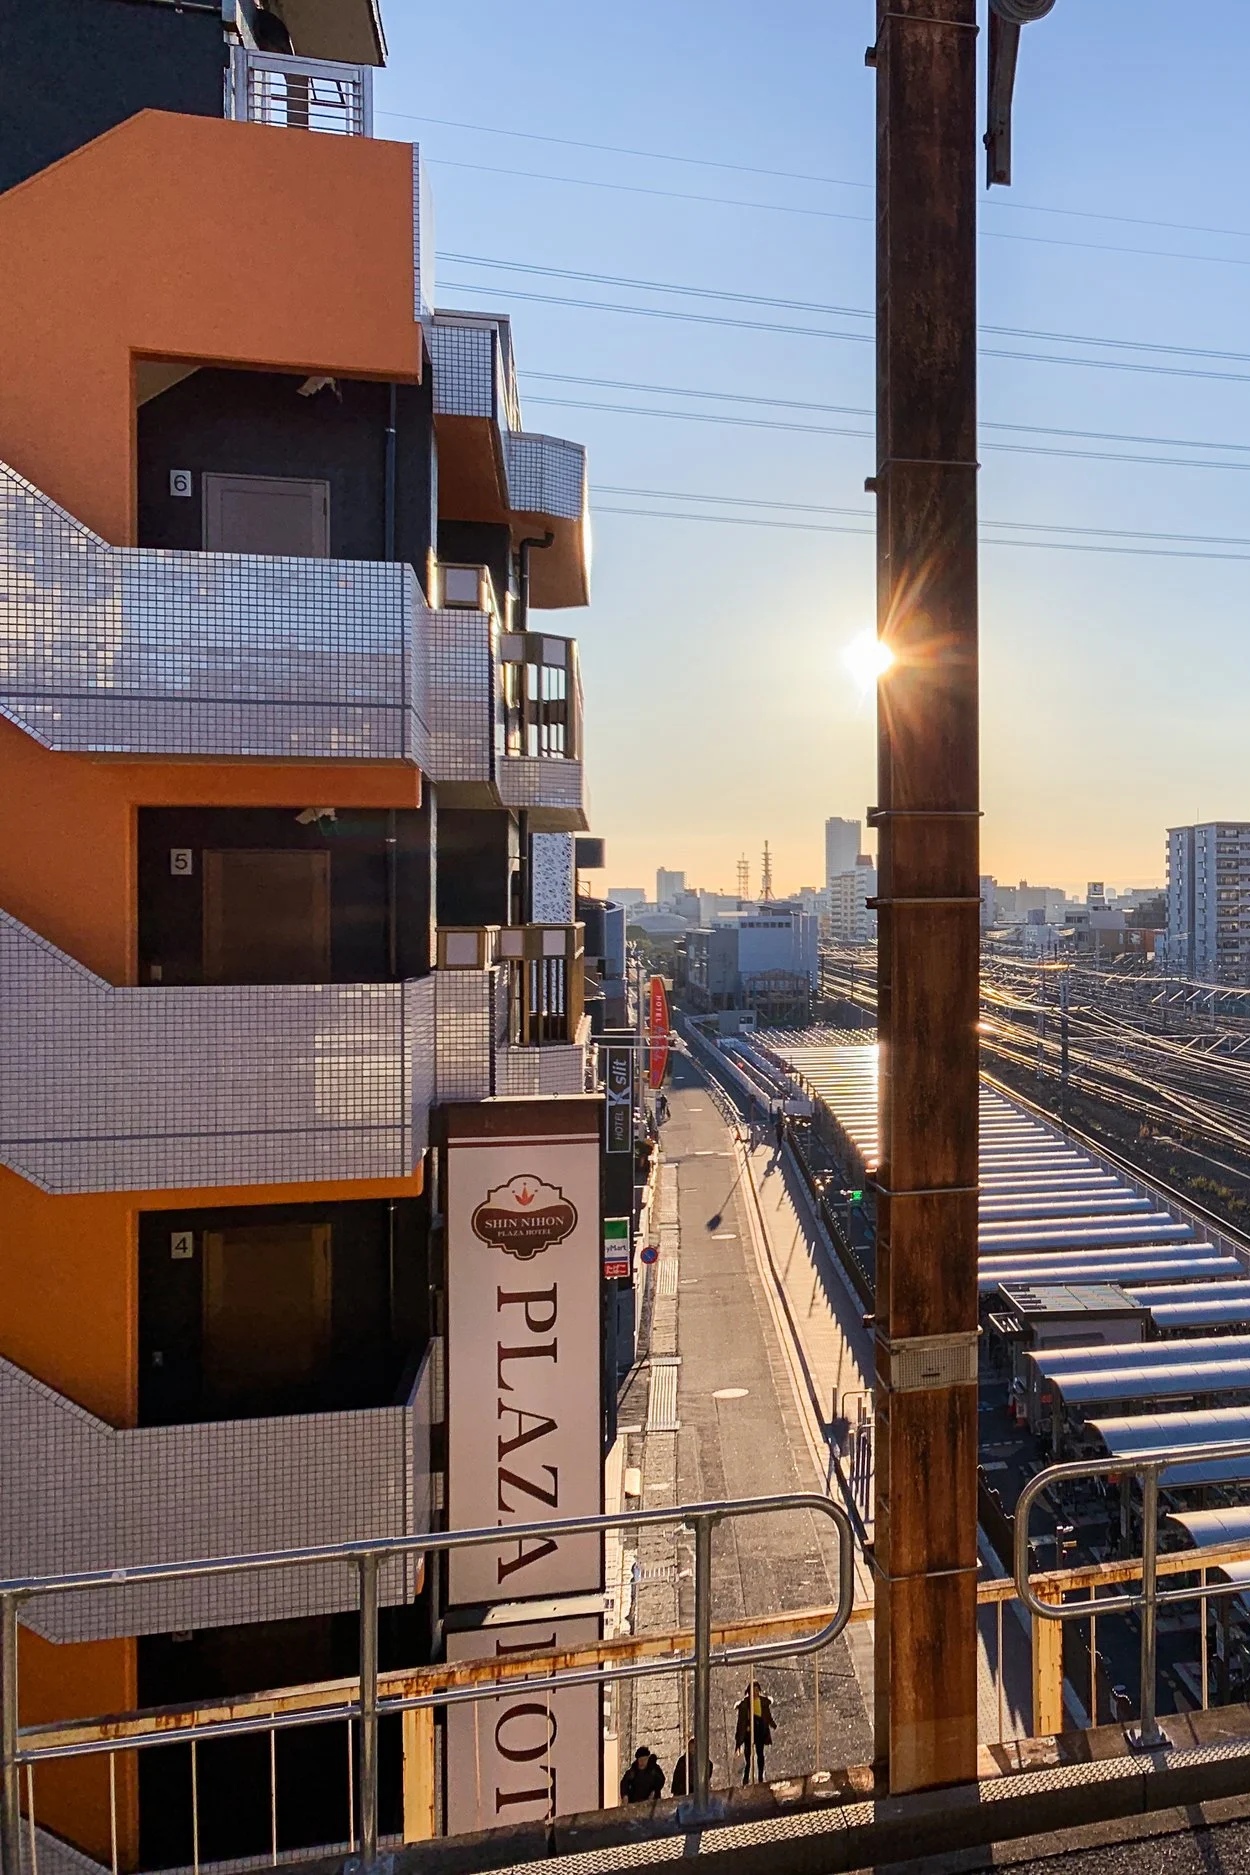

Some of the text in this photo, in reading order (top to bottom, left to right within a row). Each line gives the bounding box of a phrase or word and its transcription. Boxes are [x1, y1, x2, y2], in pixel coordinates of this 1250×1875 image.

[174, 475, 187, 491] 6
[175, 853, 188, 870] 5
[615, 1111, 624, 1141] HOTEL
[485, 1216, 565, 1229] SHIN NIHON
[526, 1228, 552, 1236] HOTEL
[175, 1237, 188, 1253] 4
[497, 1282, 559, 1585] PLAZA
